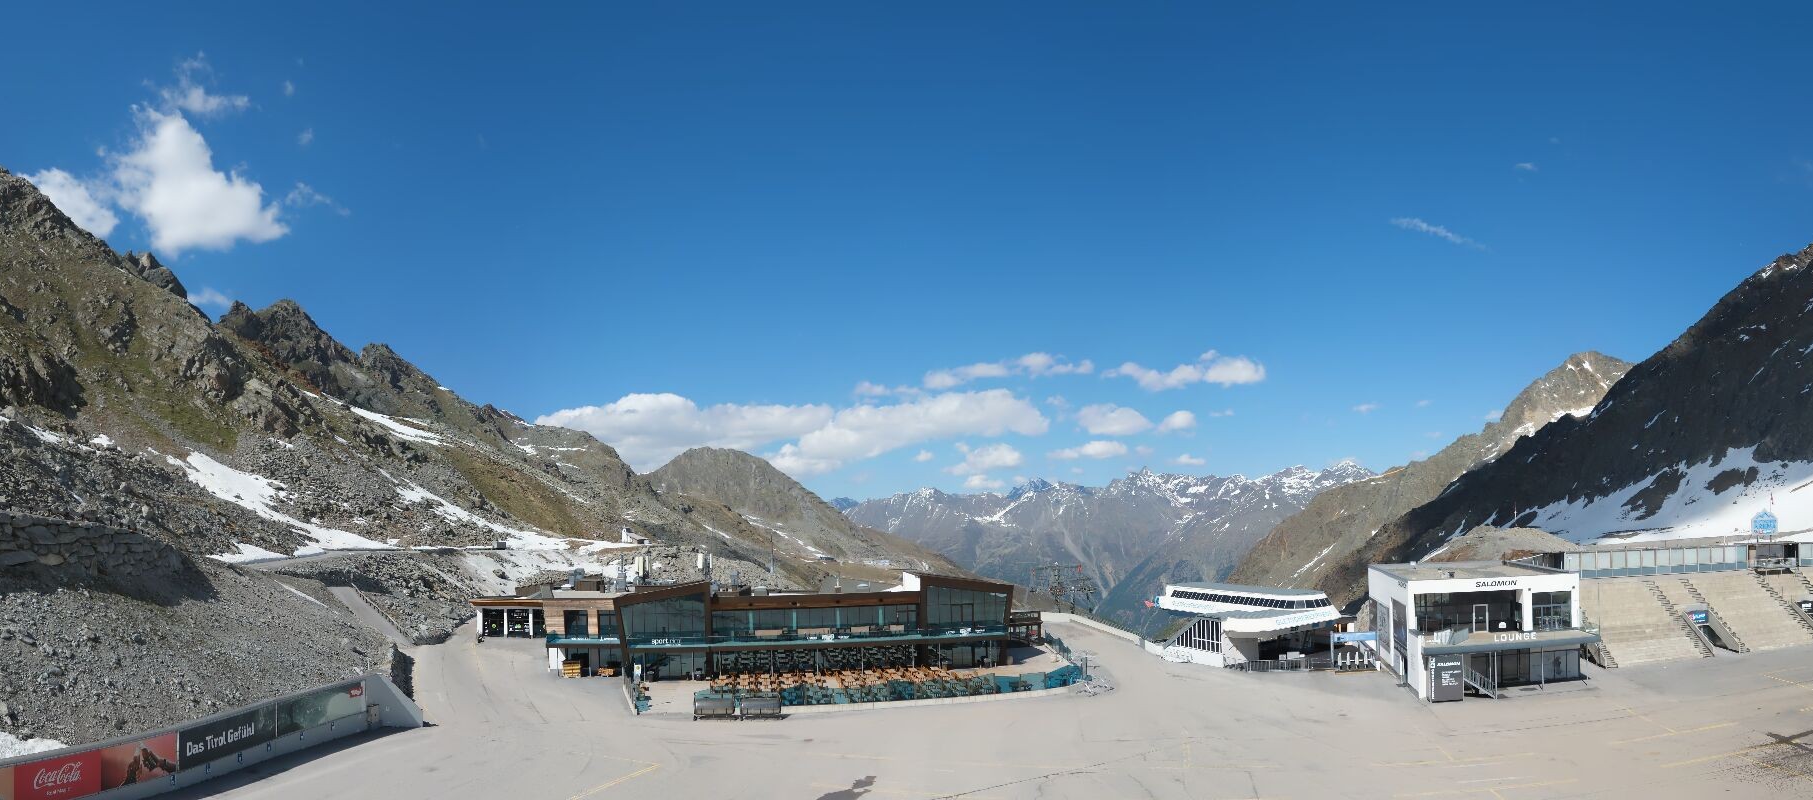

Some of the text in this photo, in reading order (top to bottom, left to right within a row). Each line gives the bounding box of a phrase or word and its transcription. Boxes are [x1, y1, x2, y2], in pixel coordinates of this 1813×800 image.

[1494, 632, 1537, 641] LOUNGE
[186, 721, 255, 757] Das Tirol Gefühl
